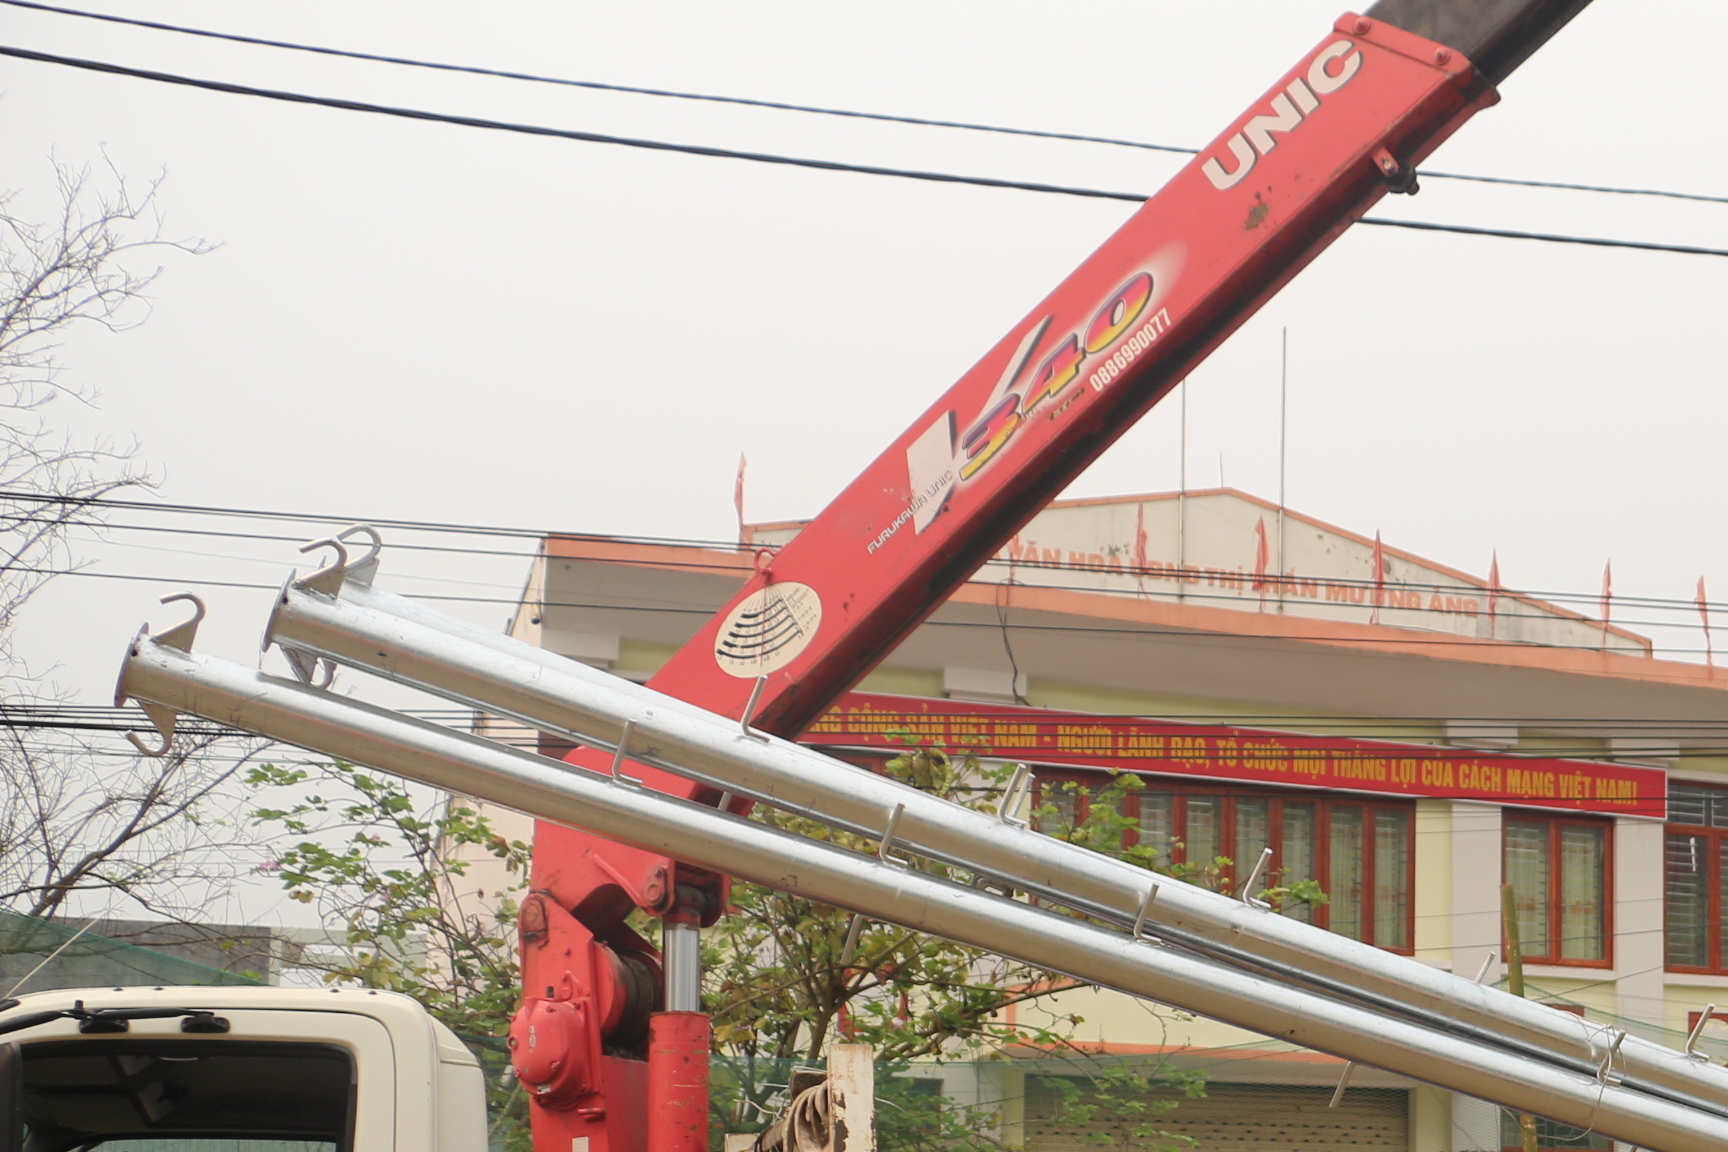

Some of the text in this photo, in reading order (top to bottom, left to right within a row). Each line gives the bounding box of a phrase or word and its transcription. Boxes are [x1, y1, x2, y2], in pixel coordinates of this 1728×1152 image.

[1201, 40, 1363, 190] UNIC
[1089, 307, 1172, 392] 0886990077
[867, 494, 928, 554] FURUKAWA
[994, 719, 1038, 748] NAM
[1057, 722, 1112, 756] NGƯỜI
[1117, 726, 1164, 760] LÃNH
[1216, 730, 1237, 767] TỔ
[1243, 738, 1288, 772] CHỨC
[1293, 747, 1326, 780] MỌI
[1332, 744, 1386, 781] THẮNG
[1390, 757, 1416, 788] LỢI
[1421, 751, 1454, 789] CỦA
[1459, 759, 1501, 792] CÁCH
[1507, 768, 1555, 799] MẠNG
[1559, 769, 1591, 806] VIỆT
[1596, 777, 1638, 806] NAM!
